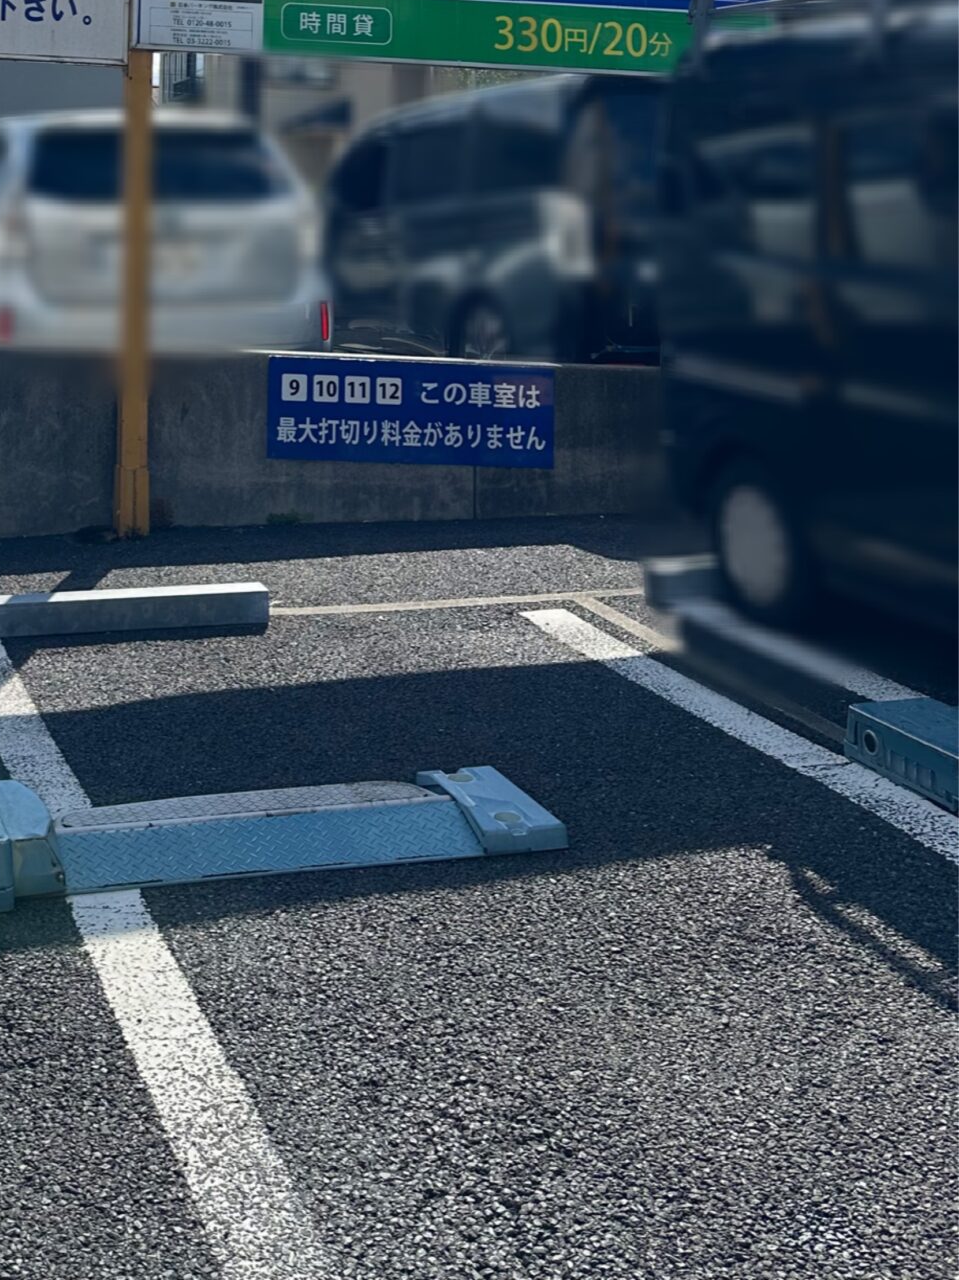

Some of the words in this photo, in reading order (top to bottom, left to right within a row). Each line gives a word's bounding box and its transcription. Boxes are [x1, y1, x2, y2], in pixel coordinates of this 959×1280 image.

[299, 10, 374, 38] 時間貸
[494, 15, 673, 57] 330円/20分
[289, 379, 299, 396] 9
[316, 380, 336, 397] 10
[347, 381, 367, 398] 11
[379, 382, 400, 400] 12
[420, 381, 541, 409] この車室は
[276, 416, 546, 451] 最大打切り料金がありません
